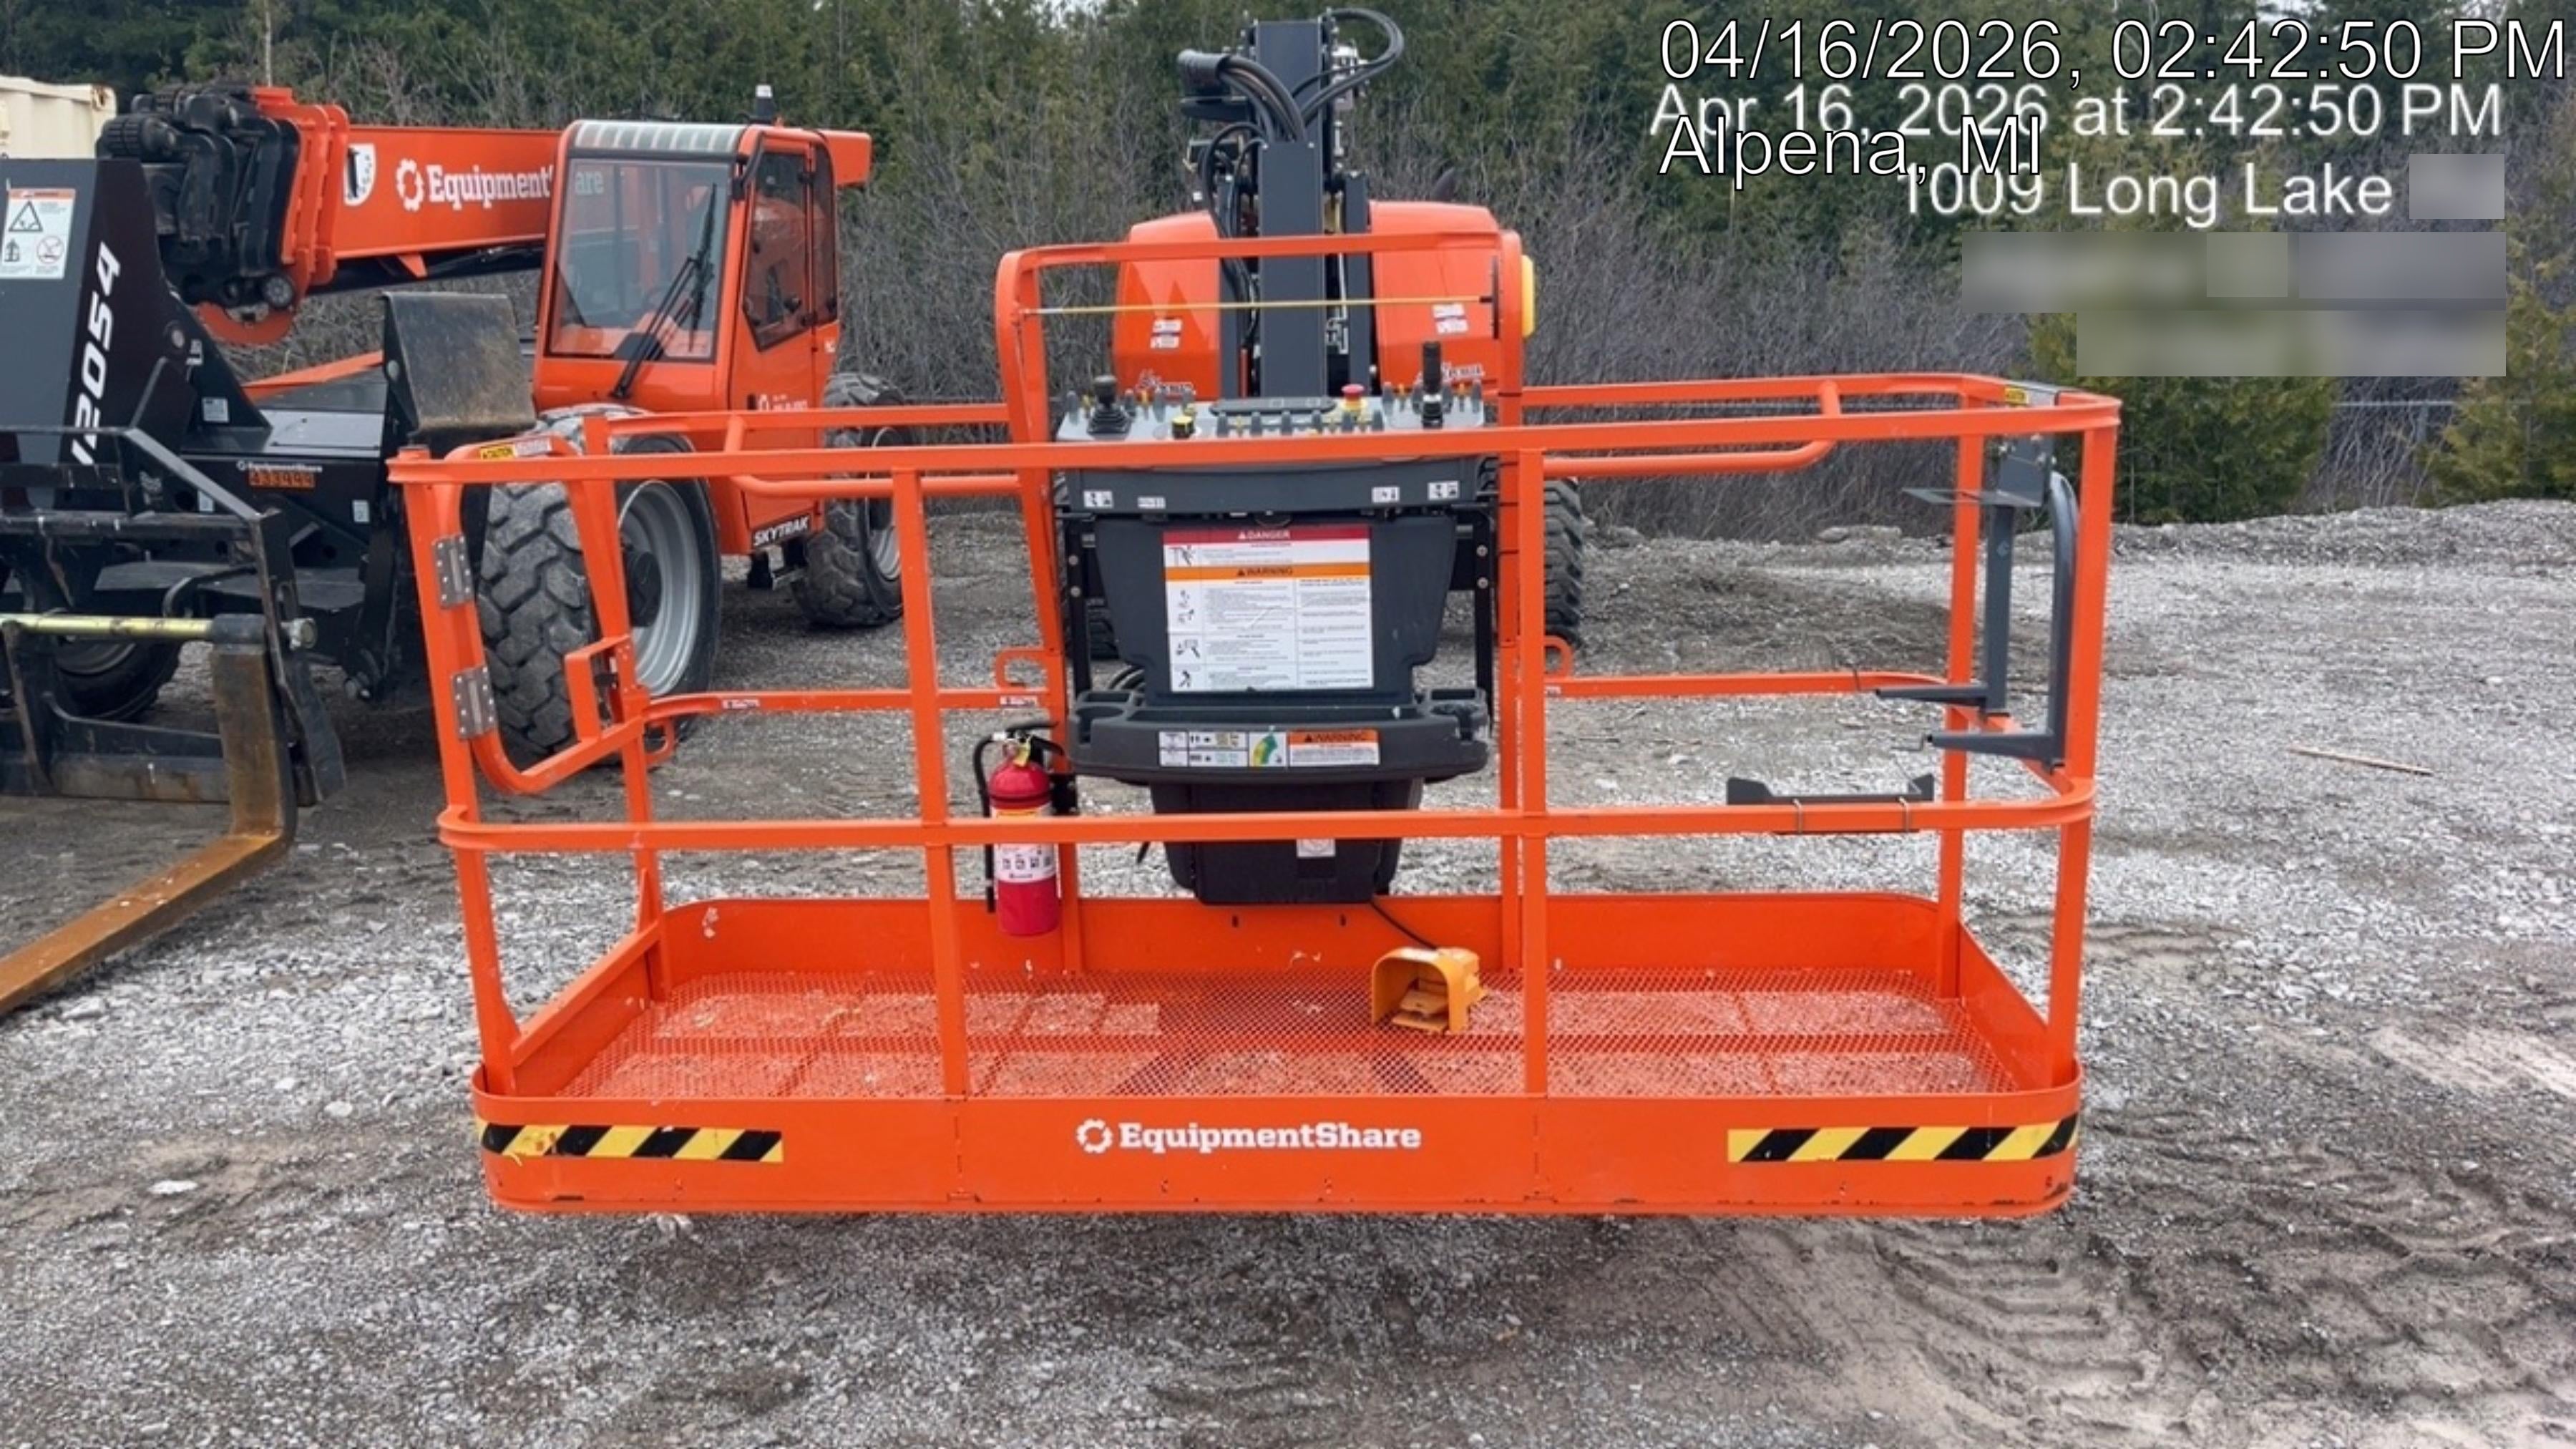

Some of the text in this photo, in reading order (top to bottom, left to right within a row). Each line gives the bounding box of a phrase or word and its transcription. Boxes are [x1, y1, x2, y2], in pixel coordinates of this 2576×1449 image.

[72, 240, 121, 466] 12054
[753, 514, 809, 547] SKYTRAK
[1246, 530, 1291, 540] DANGER
[1246, 567, 1293, 577] WARNING
[1118, 1121, 1421, 1153] EquipmentShare
